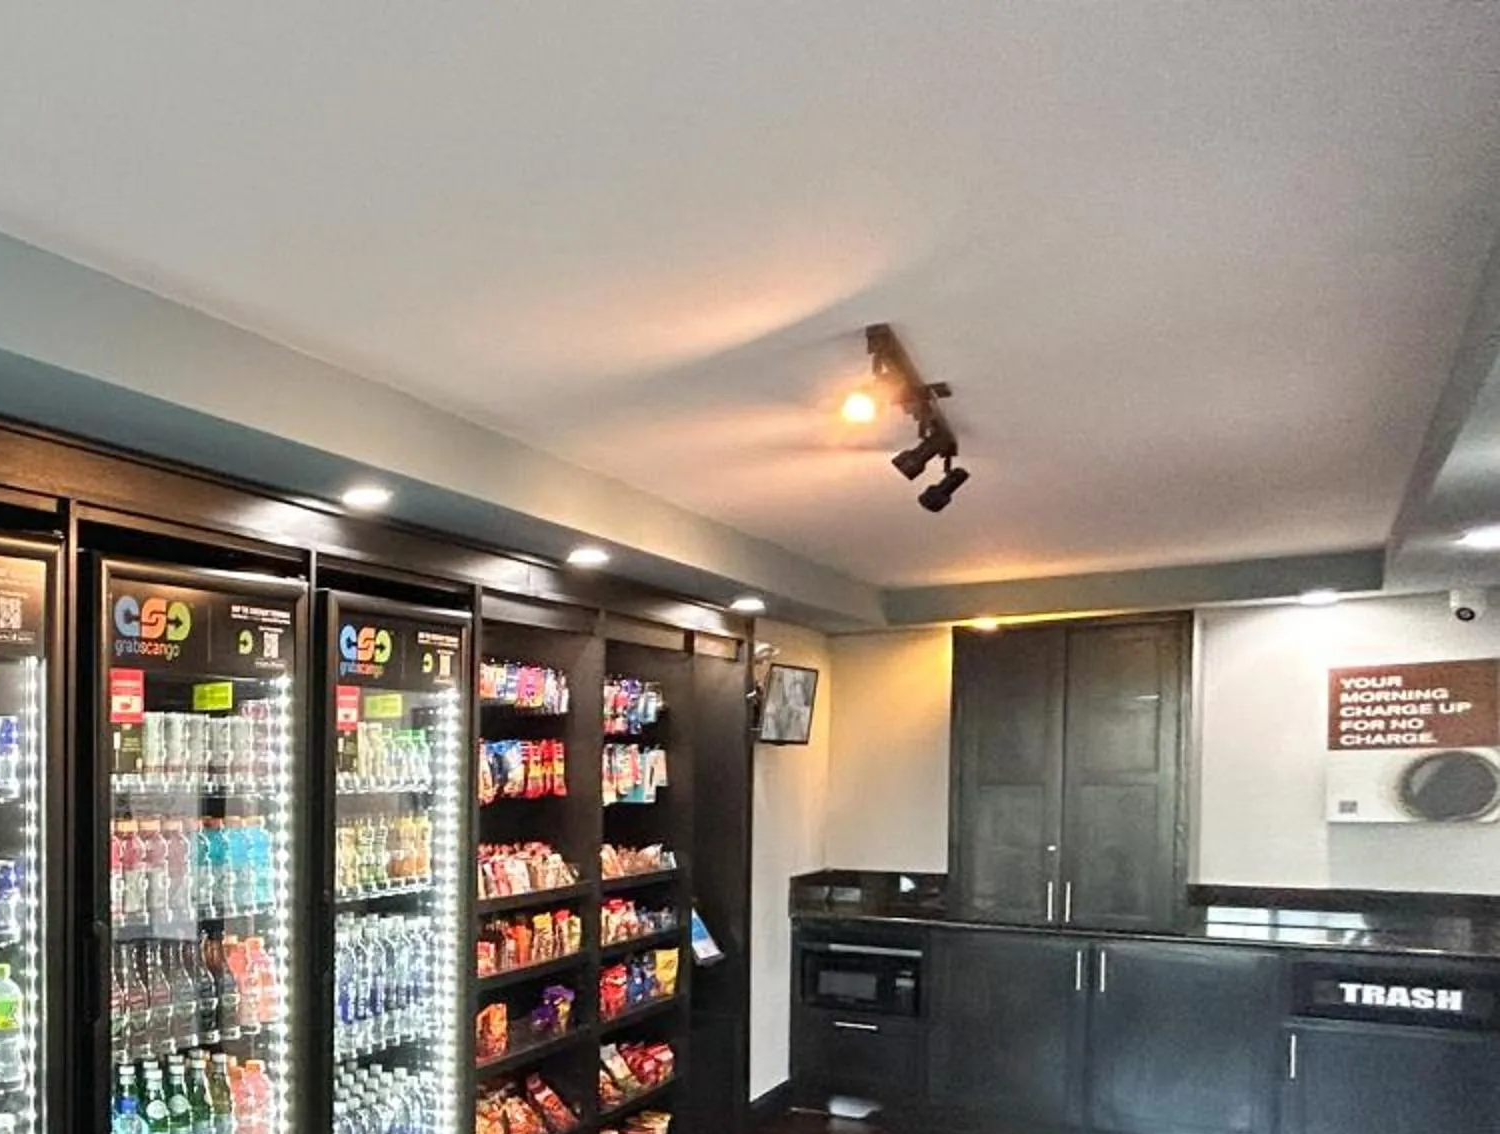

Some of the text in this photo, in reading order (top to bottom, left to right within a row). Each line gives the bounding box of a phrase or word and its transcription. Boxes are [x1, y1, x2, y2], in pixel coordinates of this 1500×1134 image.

[1339, 675, 1403, 690] YOUR
[1339, 687, 1449, 703] MORNING
[1339, 701, 1474, 718] CHARGE UP
[1339, 717, 1425, 732] FOR NO
[1339, 982, 1463, 1011] TRASH
